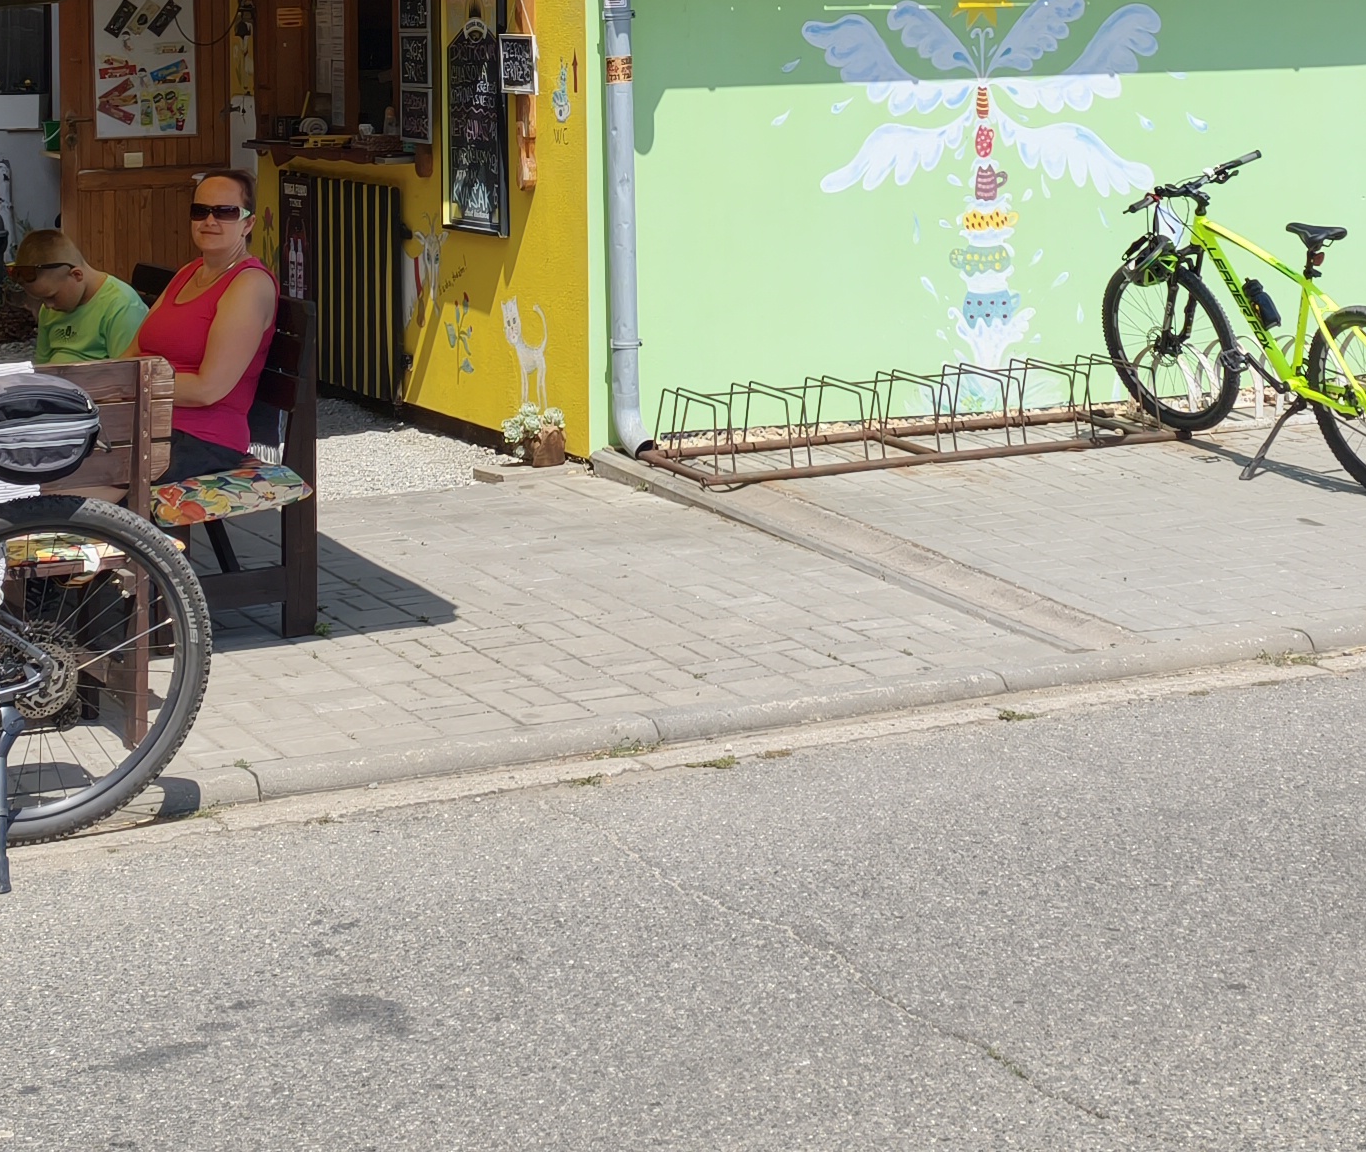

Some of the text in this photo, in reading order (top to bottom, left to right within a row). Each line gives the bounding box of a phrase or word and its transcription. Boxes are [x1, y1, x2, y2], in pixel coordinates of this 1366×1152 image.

[553, 127, 569, 146] WC
[1206, 247, 1274, 351] LEADER FOX
[135, 539, 200, 644] SMART SAM
